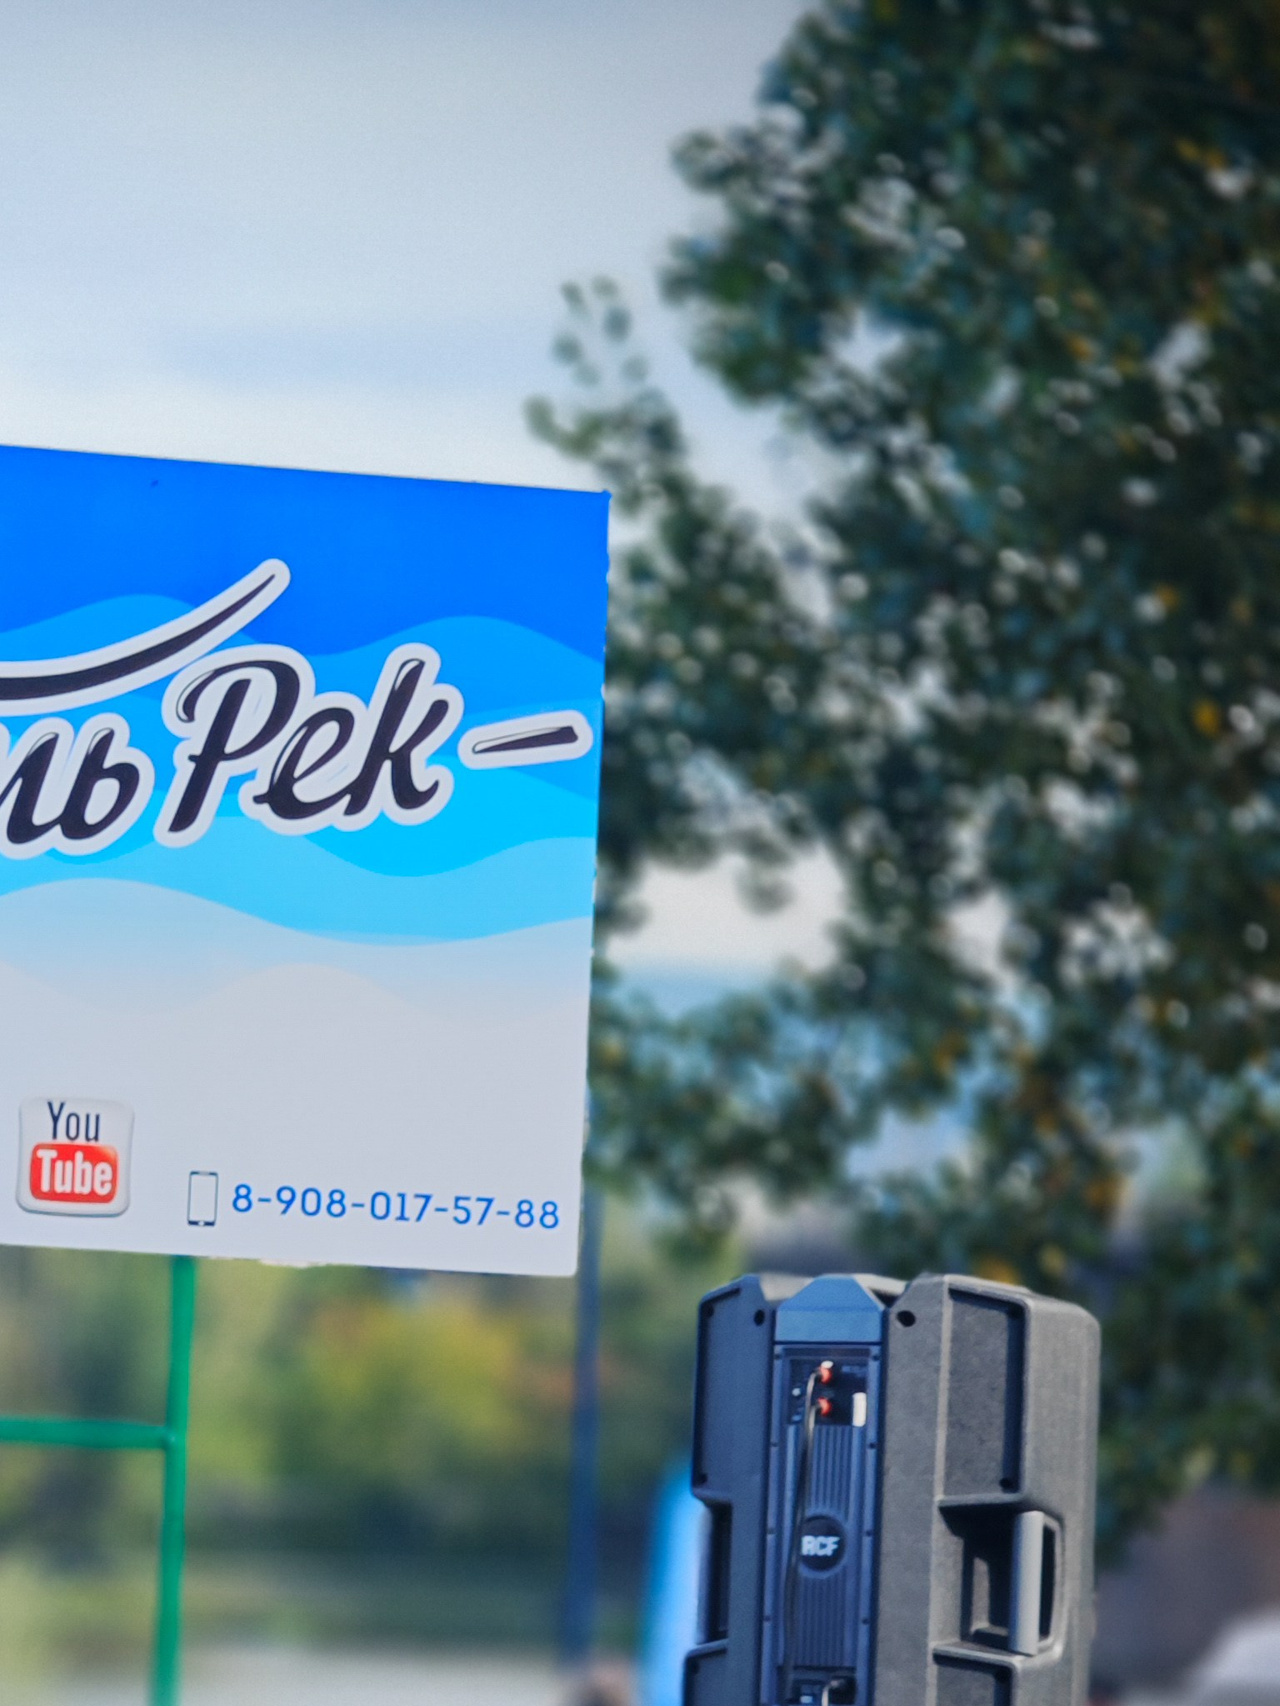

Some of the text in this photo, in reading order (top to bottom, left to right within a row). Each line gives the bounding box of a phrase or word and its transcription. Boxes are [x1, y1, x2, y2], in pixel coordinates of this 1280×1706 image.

[168, 658, 451, 833] Рек
[46, 1100, 101, 1143] You
[35, 1148, 113, 1197] Tube
[231, 1183, 560, 1229] 8-908-017-57-88
[801, 1535, 840, 1556] RCF
